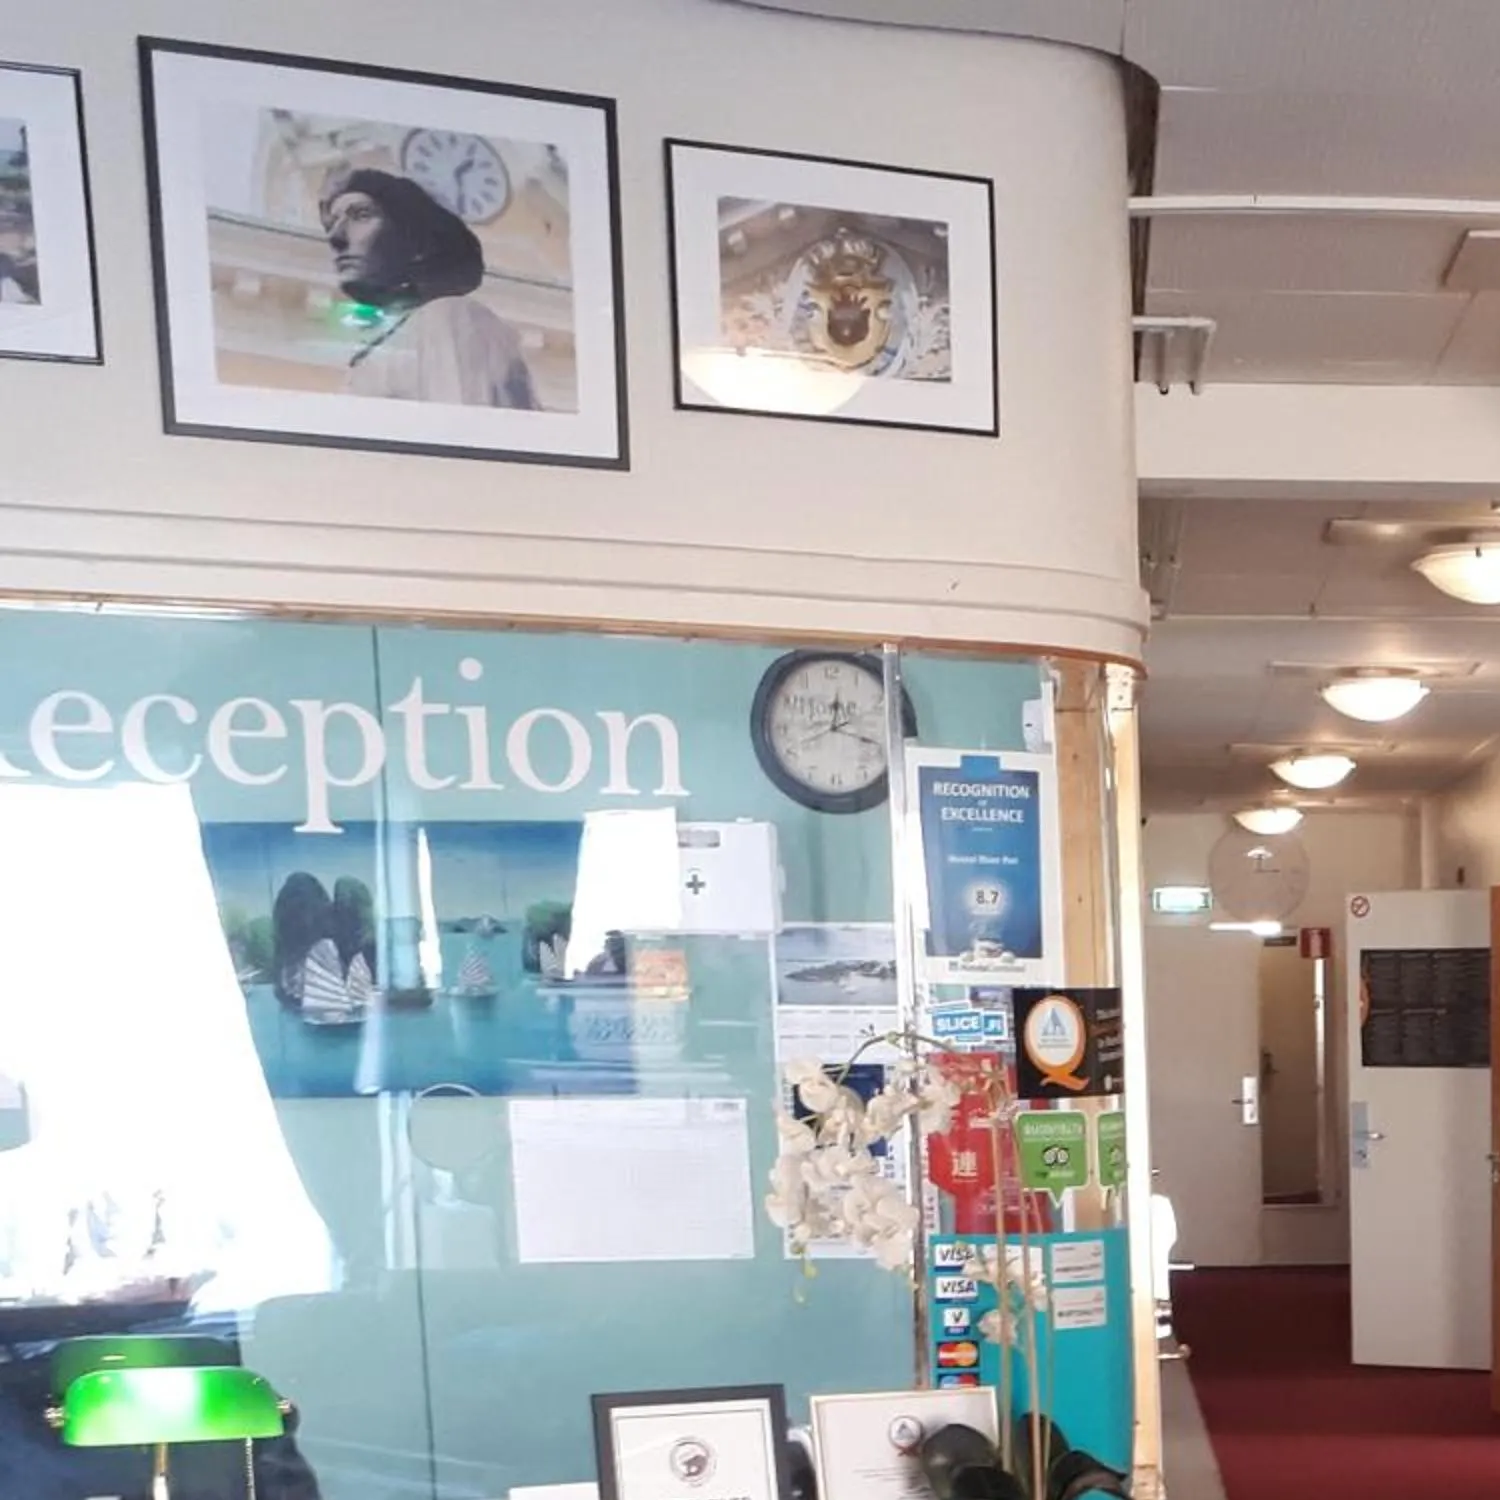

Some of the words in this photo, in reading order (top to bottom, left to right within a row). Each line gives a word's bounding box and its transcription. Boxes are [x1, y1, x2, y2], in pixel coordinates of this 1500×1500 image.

[0, 657, 690, 833] eception
[932, 781, 1029, 798] RECOGNITION
[940, 807, 1024, 823] EXCELLENCE
[975, 889, 999, 905] 8.7
[941, 1281, 976, 1294] VISA
